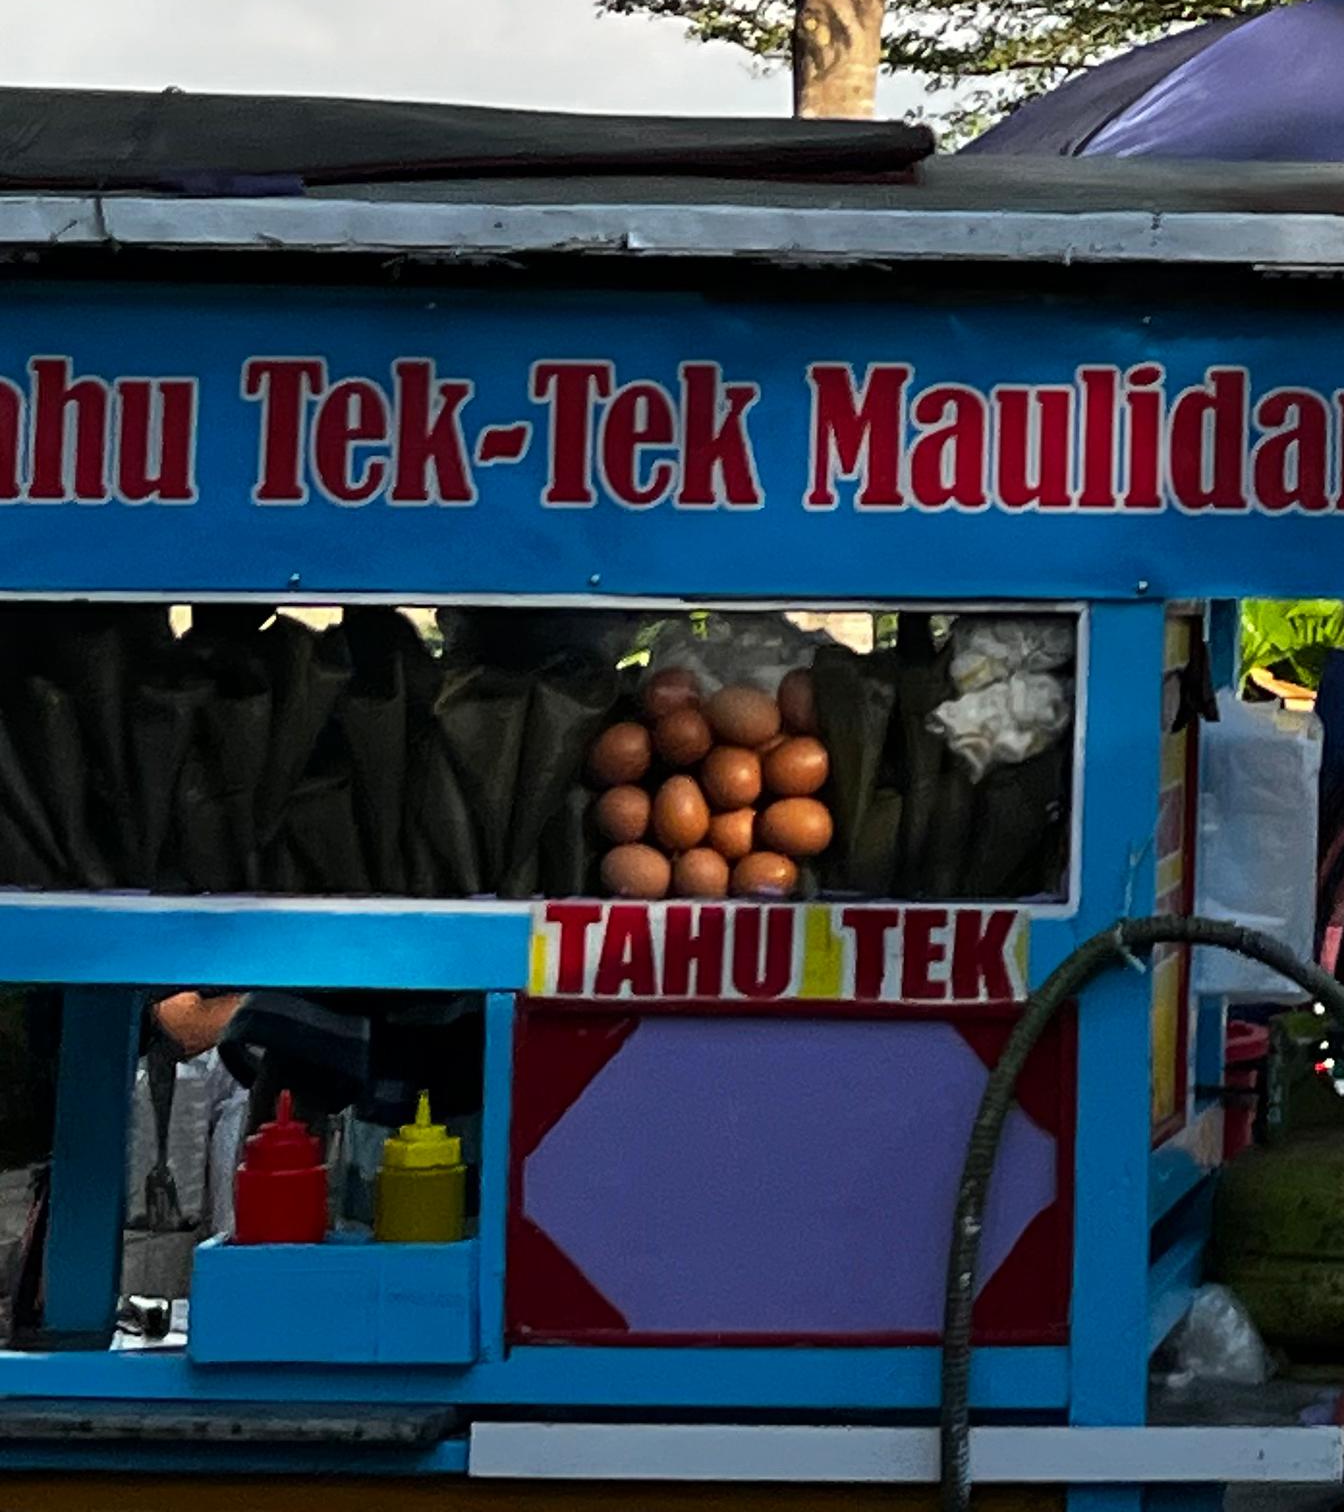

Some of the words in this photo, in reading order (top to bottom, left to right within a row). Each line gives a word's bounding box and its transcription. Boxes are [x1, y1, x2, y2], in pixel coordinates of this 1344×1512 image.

[241, 356, 765, 510] Tek-Tek
[546, 903, 796, 999] TAHU
[842, 907, 1020, 1001] TEK
